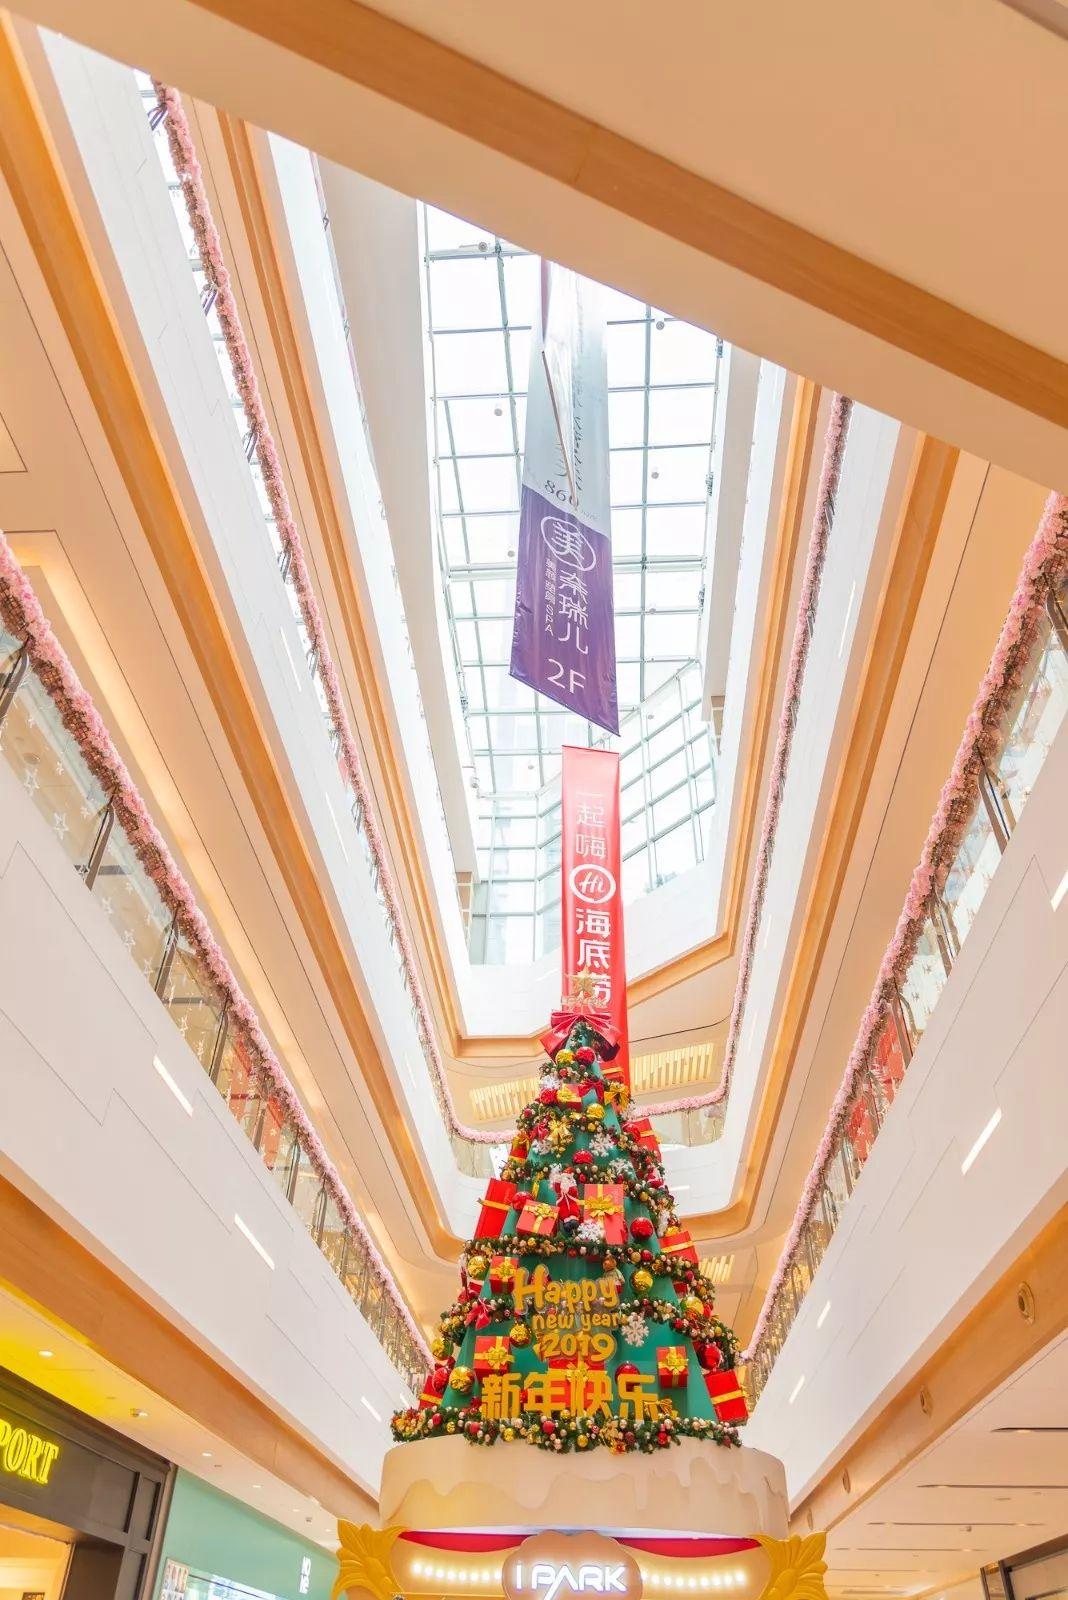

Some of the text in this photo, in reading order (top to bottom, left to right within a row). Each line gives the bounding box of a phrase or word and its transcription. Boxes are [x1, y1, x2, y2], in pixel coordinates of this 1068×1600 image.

[558, 572, 588, 655] 奈瑞儿
[547, 658, 586, 694] 2F
[576, 793, 606, 860] 一起嗨
[579, 872, 605, 894] Hi
[513, 1264, 619, 1314] Happy
[532, 1312, 619, 1332] new year
[539, 1330, 617, 1362] 2019
[481, 1371, 659, 1422] 新年快乐
[531, 1563, 628, 1600] PARK
